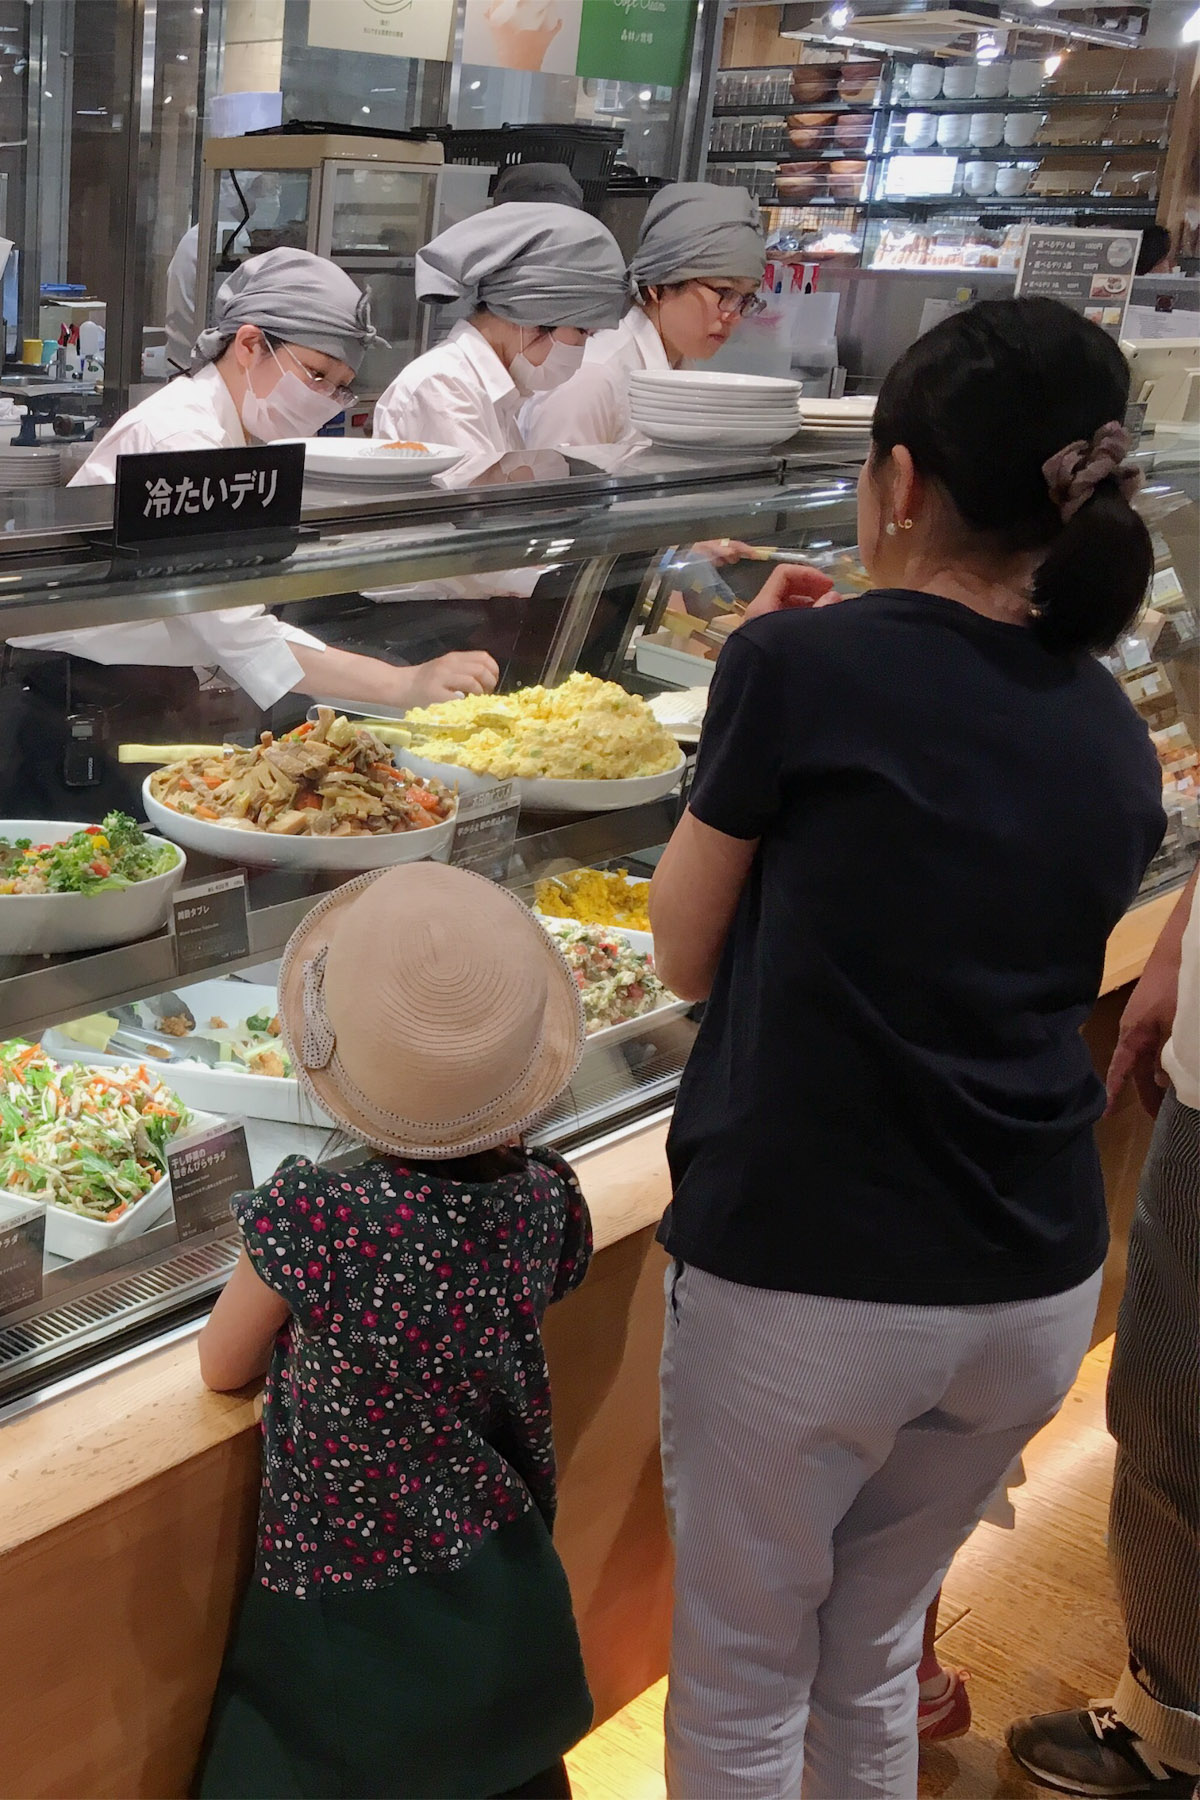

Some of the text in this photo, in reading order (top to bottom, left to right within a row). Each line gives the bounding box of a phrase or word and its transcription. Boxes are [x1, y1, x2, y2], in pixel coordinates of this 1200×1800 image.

[143, 469, 278, 518] 冷たいデリ
[171, 1149, 206, 1168] 干し野菜の
